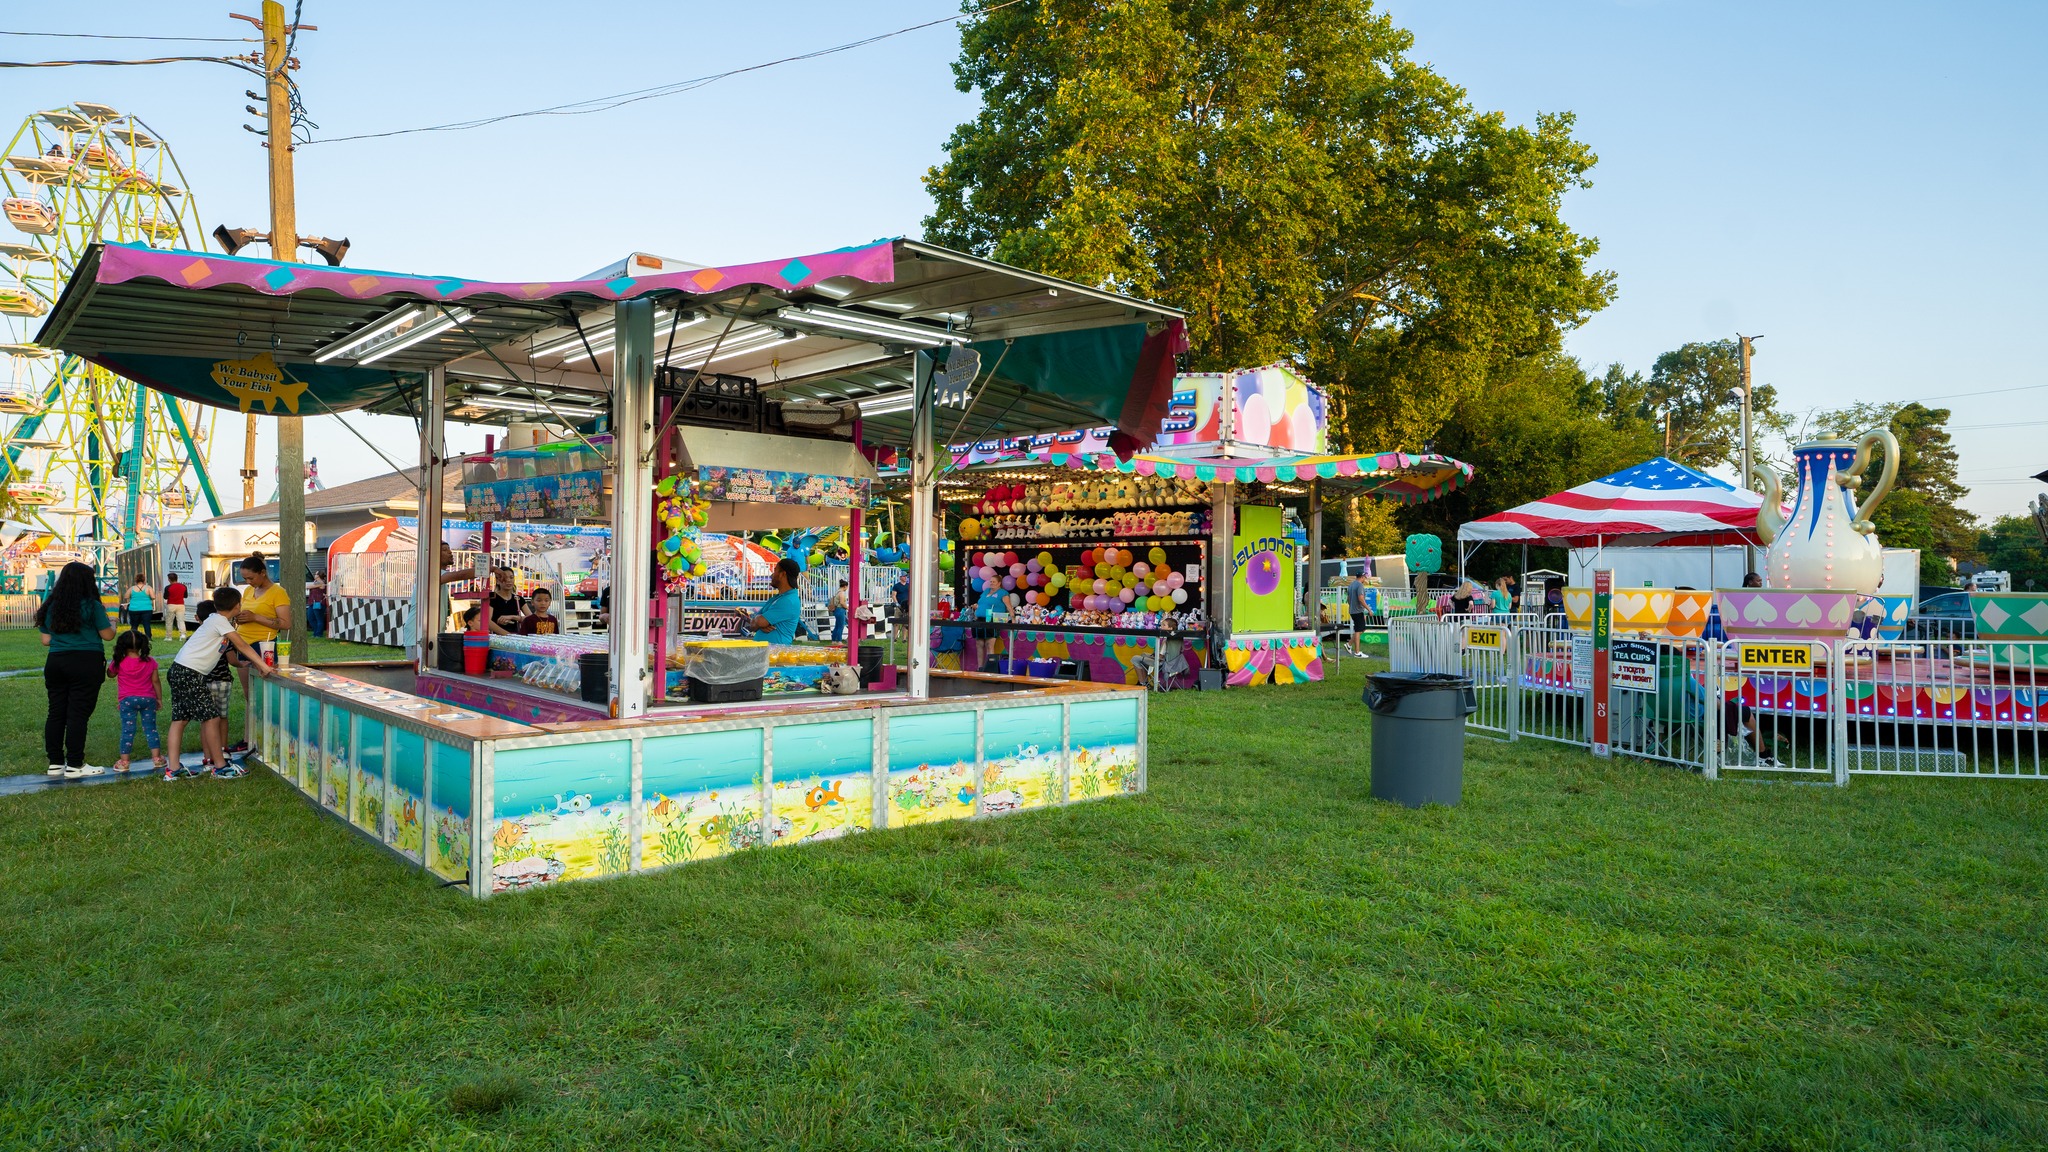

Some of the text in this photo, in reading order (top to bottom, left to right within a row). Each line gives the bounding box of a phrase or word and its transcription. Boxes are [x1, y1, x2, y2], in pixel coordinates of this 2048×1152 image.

[219, 364, 277, 382] We Babysit
[222, 376, 272, 393] Your Fish
[684, 616, 741, 632] EDWAY
[1598, 607, 1608, 637] YES
[1471, 632, 1497, 645] EXIT
[1612, 642, 1655, 656] OLLY SHOWS
[1614, 651, 1651, 662] TEA CUPS
[1745, 648, 1807, 664] ENTER
[1623, 665, 1645, 675] TICKETS
[1632, 675, 1653, 684] HEIGHT
[631, 702, 637, 710] 4
[1597, 702, 1606, 718] NO
